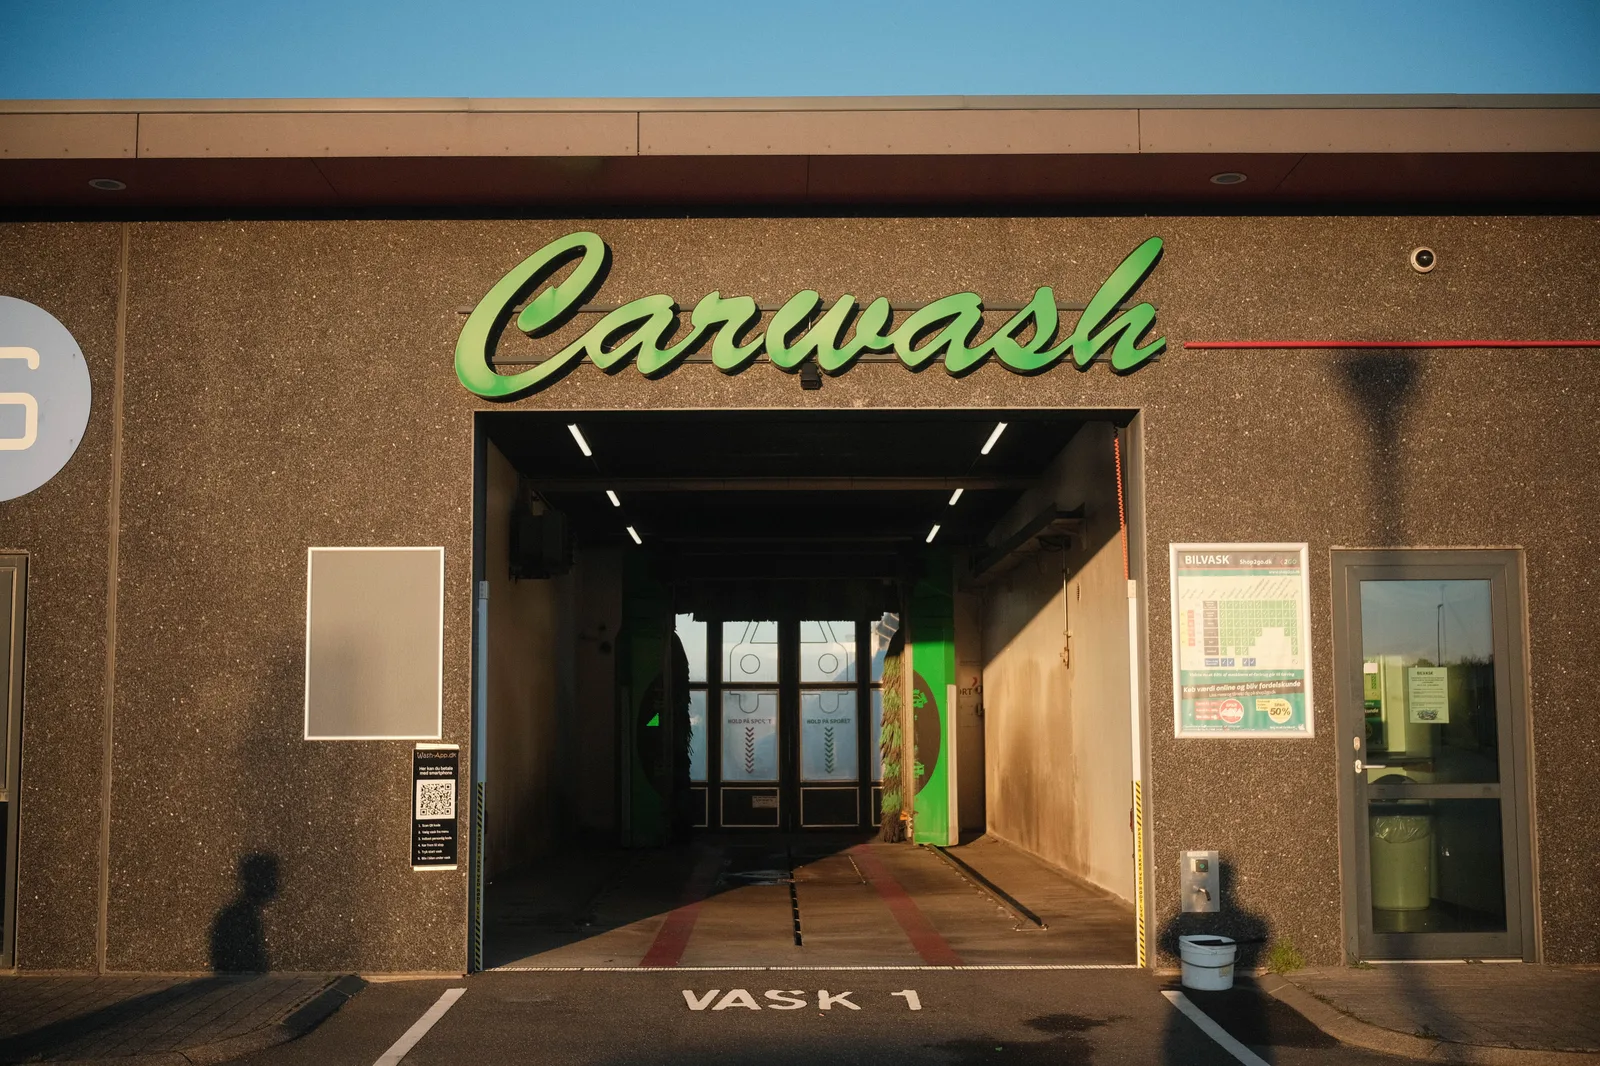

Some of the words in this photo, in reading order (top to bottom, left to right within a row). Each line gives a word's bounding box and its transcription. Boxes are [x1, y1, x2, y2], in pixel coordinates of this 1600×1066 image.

[454, 231, 1166, 399] Carwash
[1185, 555, 1230, 565] BILVASK
[1259, 681, 1301, 690] fordelskunde
[1270, 708, 1290, 716] 50%
[681, 989, 862, 1011] VASK
[891, 989, 922, 1011] 1
